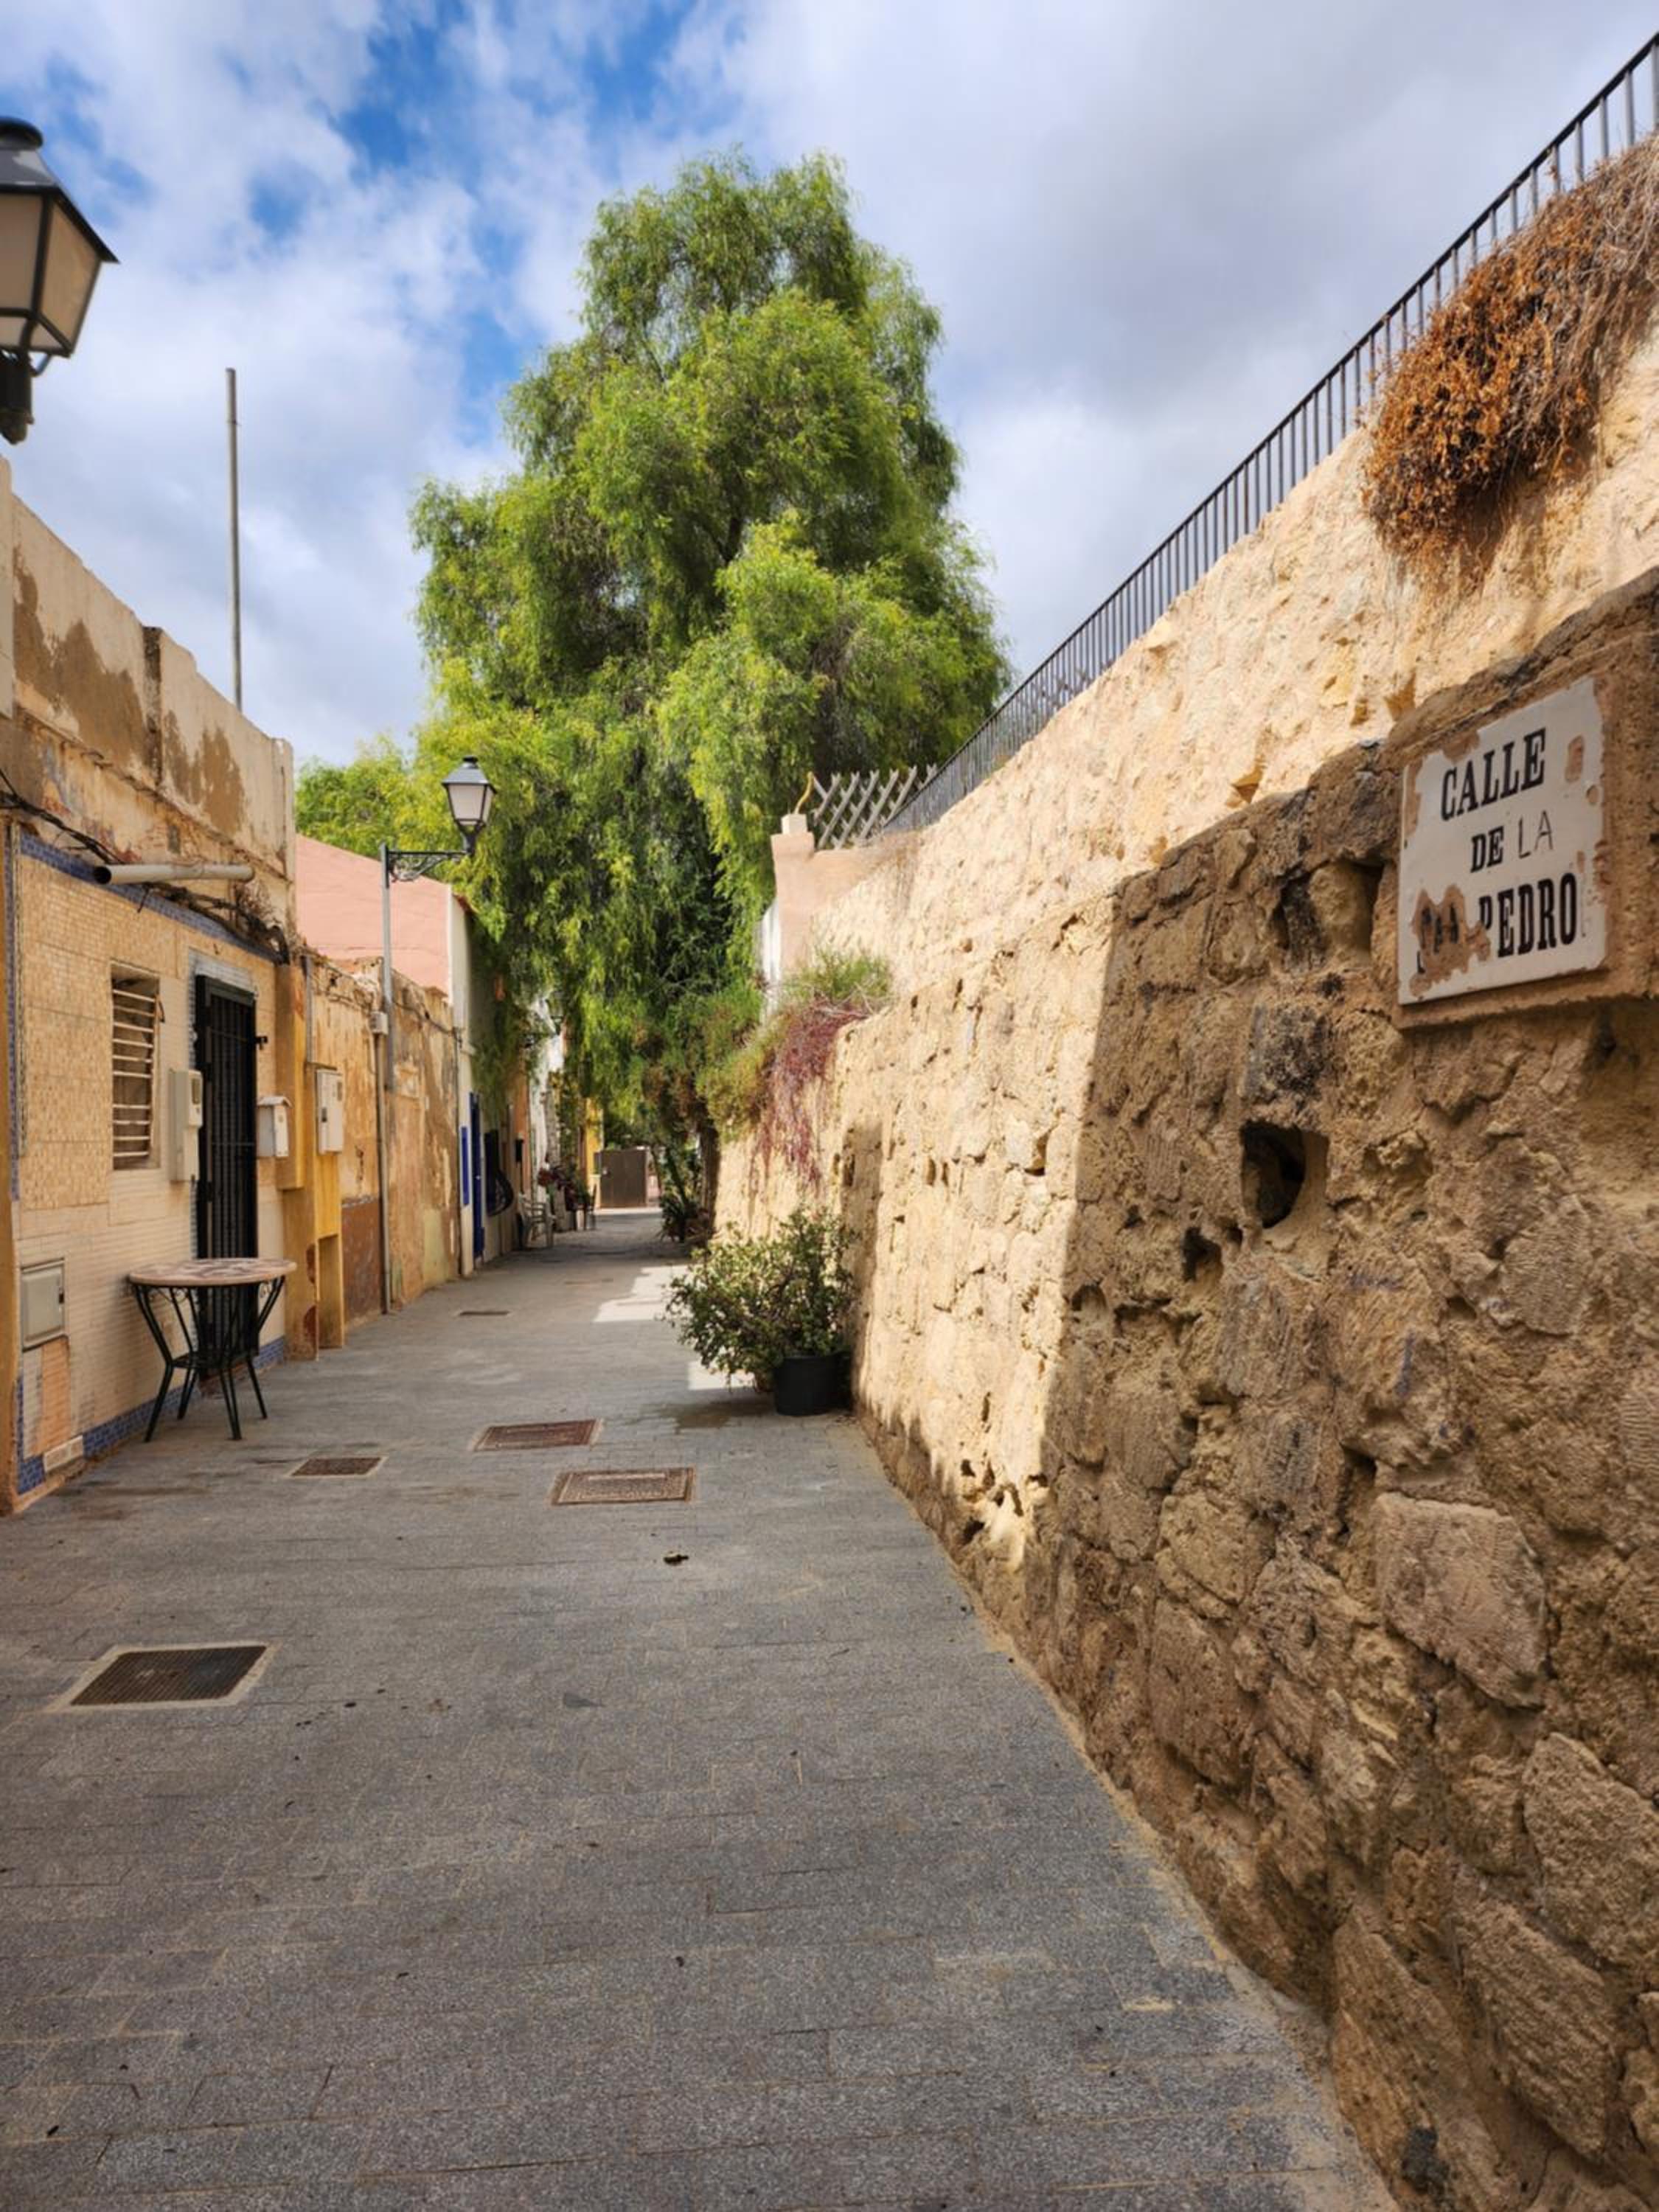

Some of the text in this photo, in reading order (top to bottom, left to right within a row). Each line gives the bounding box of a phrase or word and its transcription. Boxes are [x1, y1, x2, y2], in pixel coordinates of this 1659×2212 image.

[1441, 726, 1546, 821] CALLE
[1470, 810, 1554, 873] DE LA
[1478, 872, 1577, 958] PEDRO
